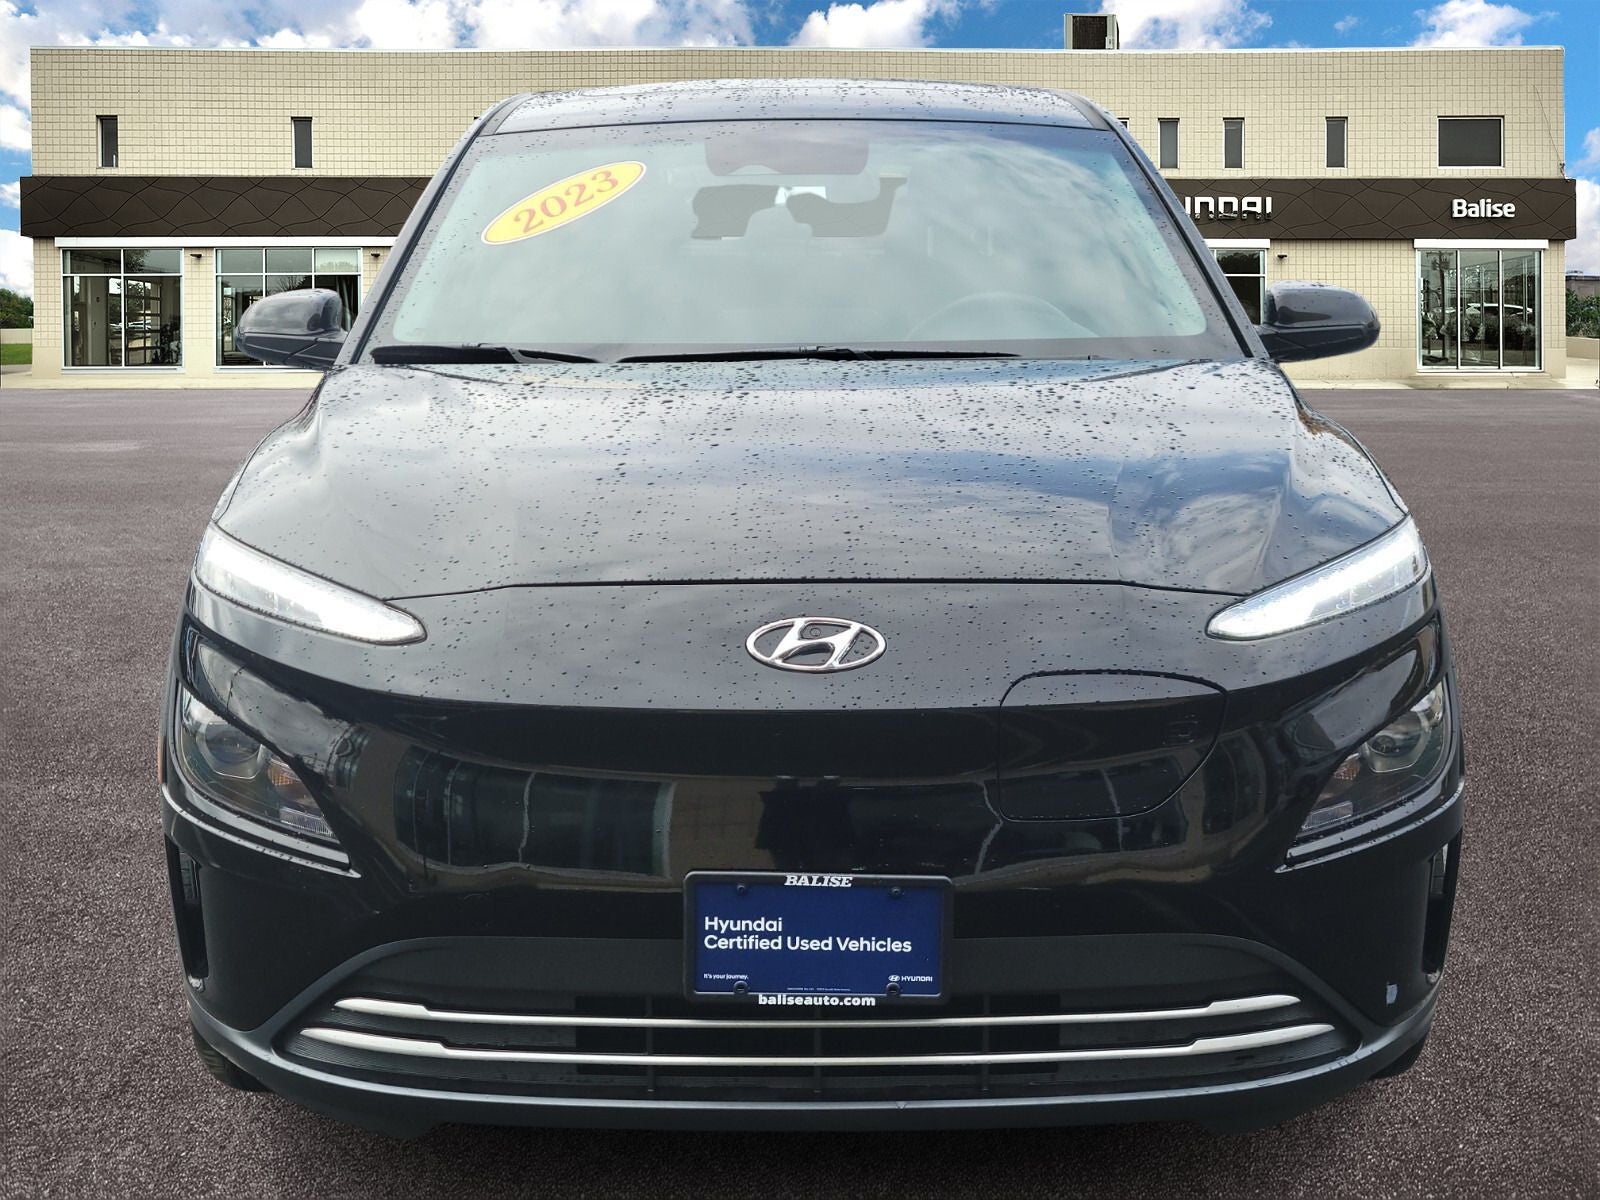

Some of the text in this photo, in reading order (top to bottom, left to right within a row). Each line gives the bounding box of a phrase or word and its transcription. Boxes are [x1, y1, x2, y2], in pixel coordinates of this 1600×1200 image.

[513, 170, 618, 233] 2023
[1452, 198, 1515, 218] Balise
[784, 875, 852, 888] BALISE
[704, 916, 782, 935] Hyundai
[704, 935, 912, 952] Certified Used Vehicles
[758, 994, 876, 1007] baliseauto.com
